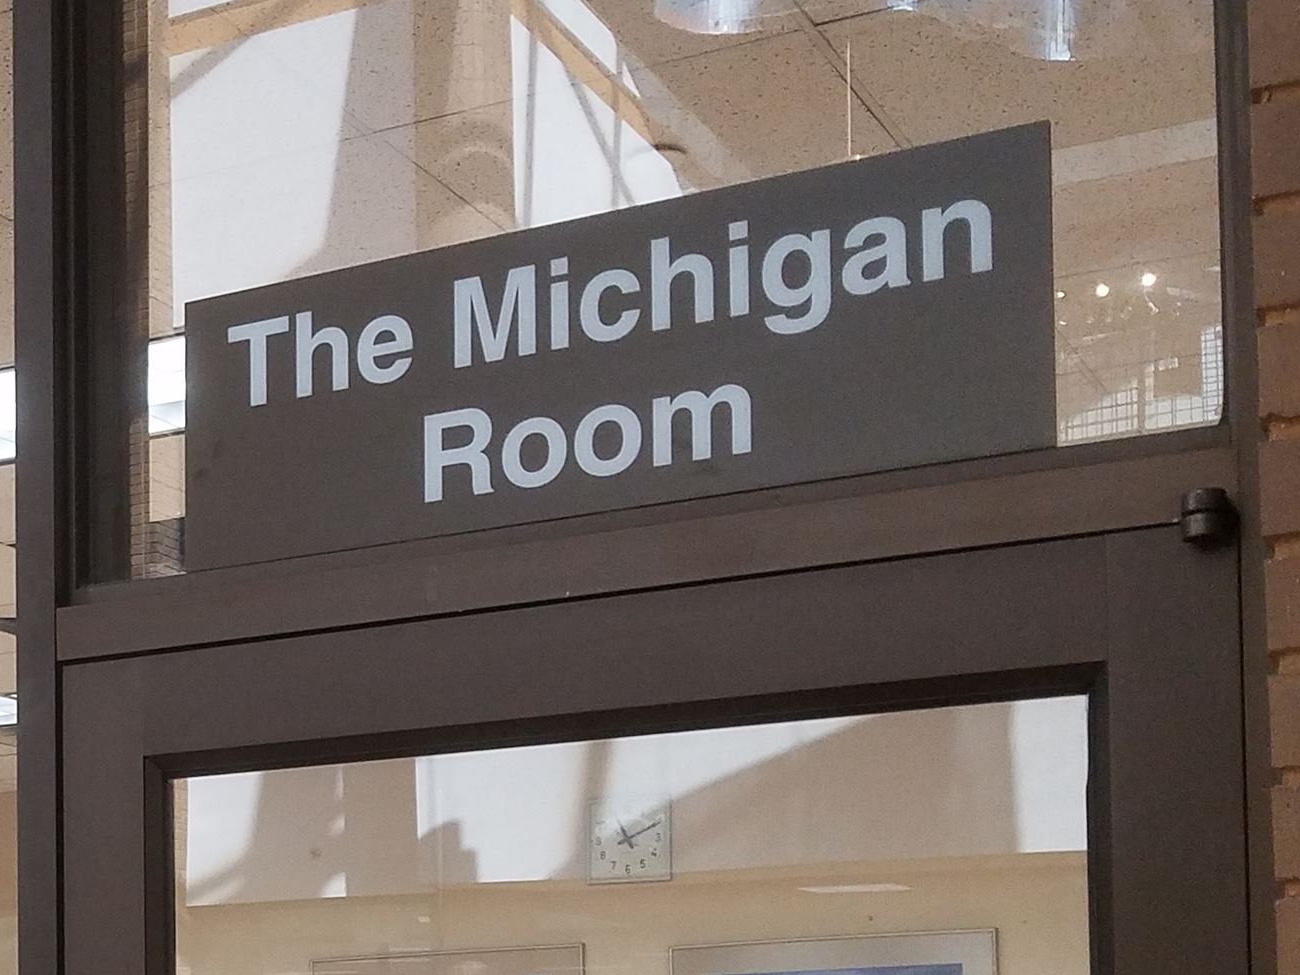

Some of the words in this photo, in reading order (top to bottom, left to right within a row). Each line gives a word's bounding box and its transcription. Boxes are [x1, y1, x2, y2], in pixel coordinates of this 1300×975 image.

[227, 310, 414, 407] The
[452, 198, 994, 369] Michigan
[422, 383, 752, 503] Room
